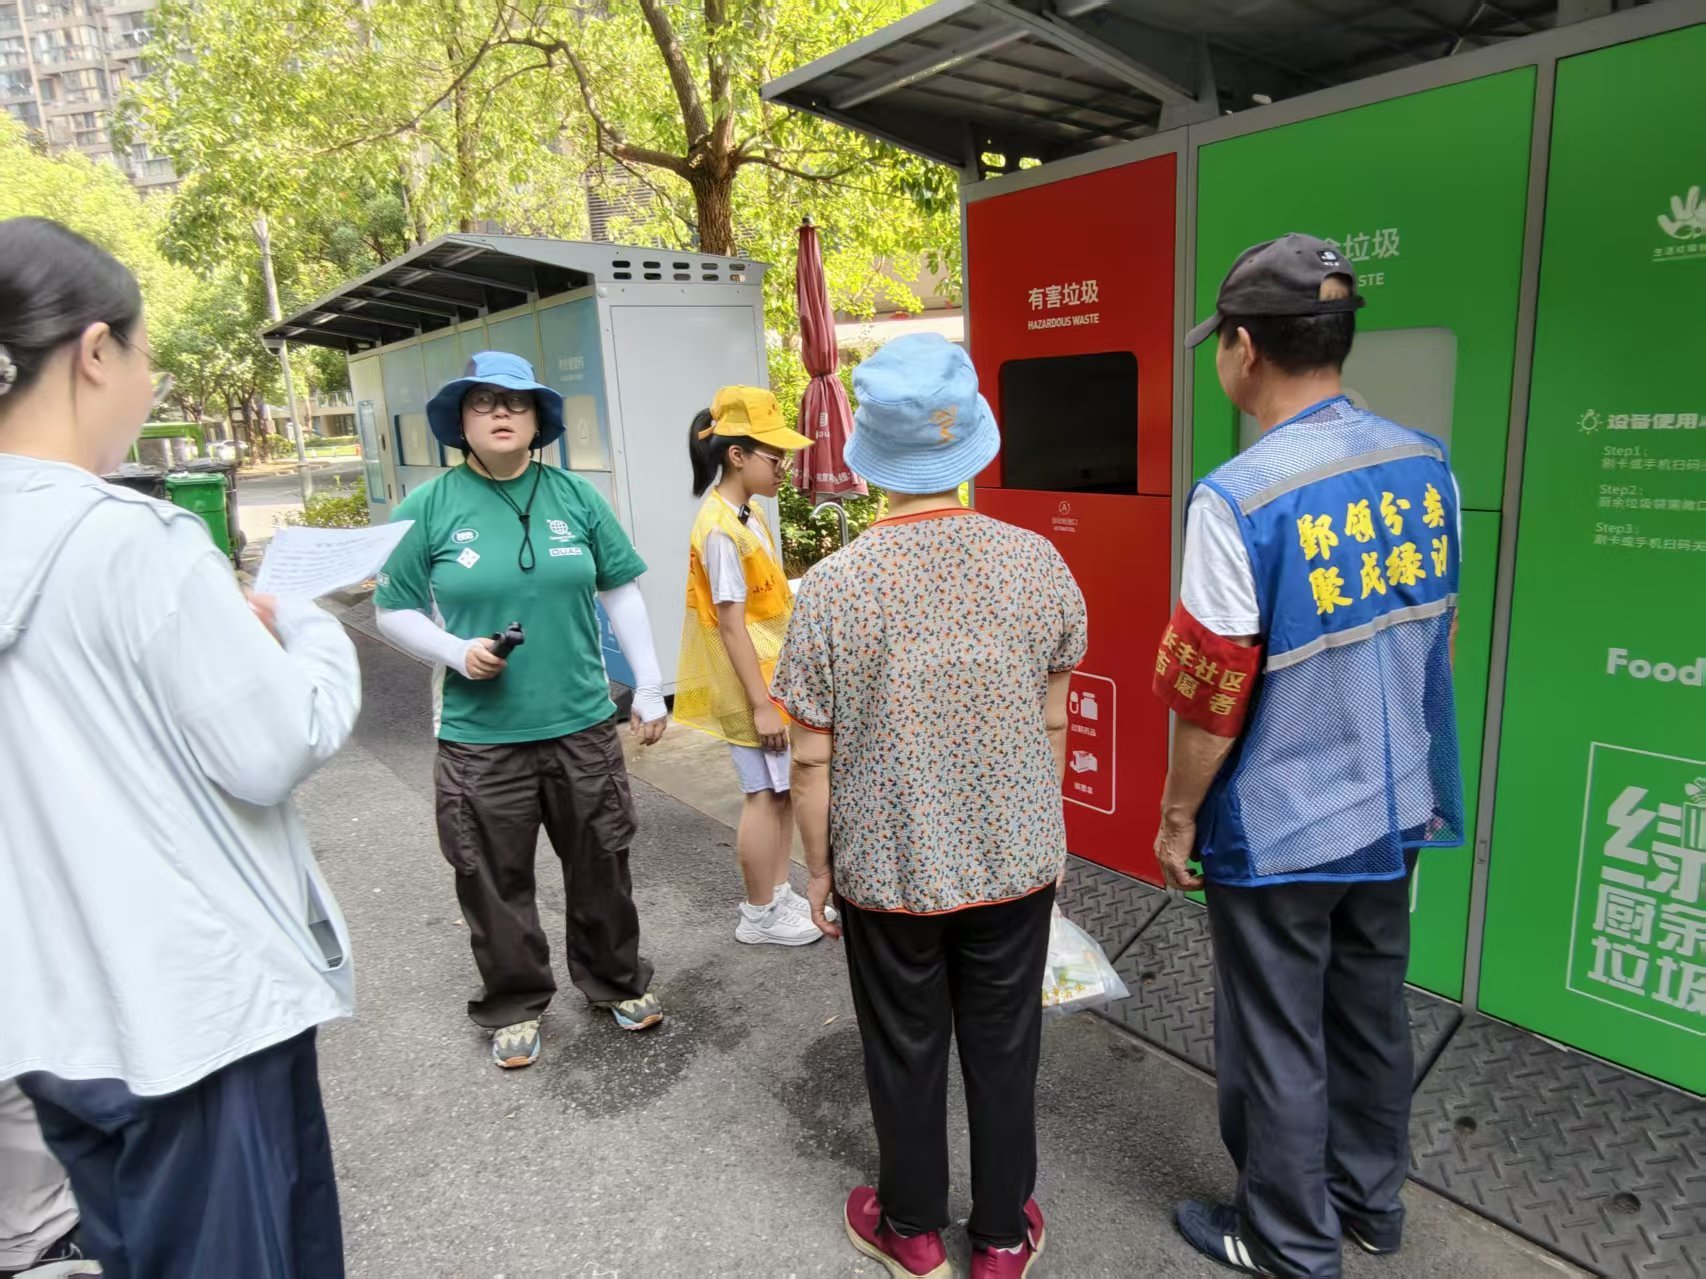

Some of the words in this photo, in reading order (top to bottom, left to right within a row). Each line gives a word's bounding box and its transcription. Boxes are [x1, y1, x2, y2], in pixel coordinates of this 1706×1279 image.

[1327, 228, 1400, 262] 垃圾
[1028, 279, 1099, 311] 有害垃圾
[1358, 272, 1385, 288] STE
[1028, 316, 1072, 331] HAZARDOUS
[1072, 313, 1099, 326] WASTE
[1606, 647, 1706, 687] Food
[1593, 883, 1706, 957] 厨余
